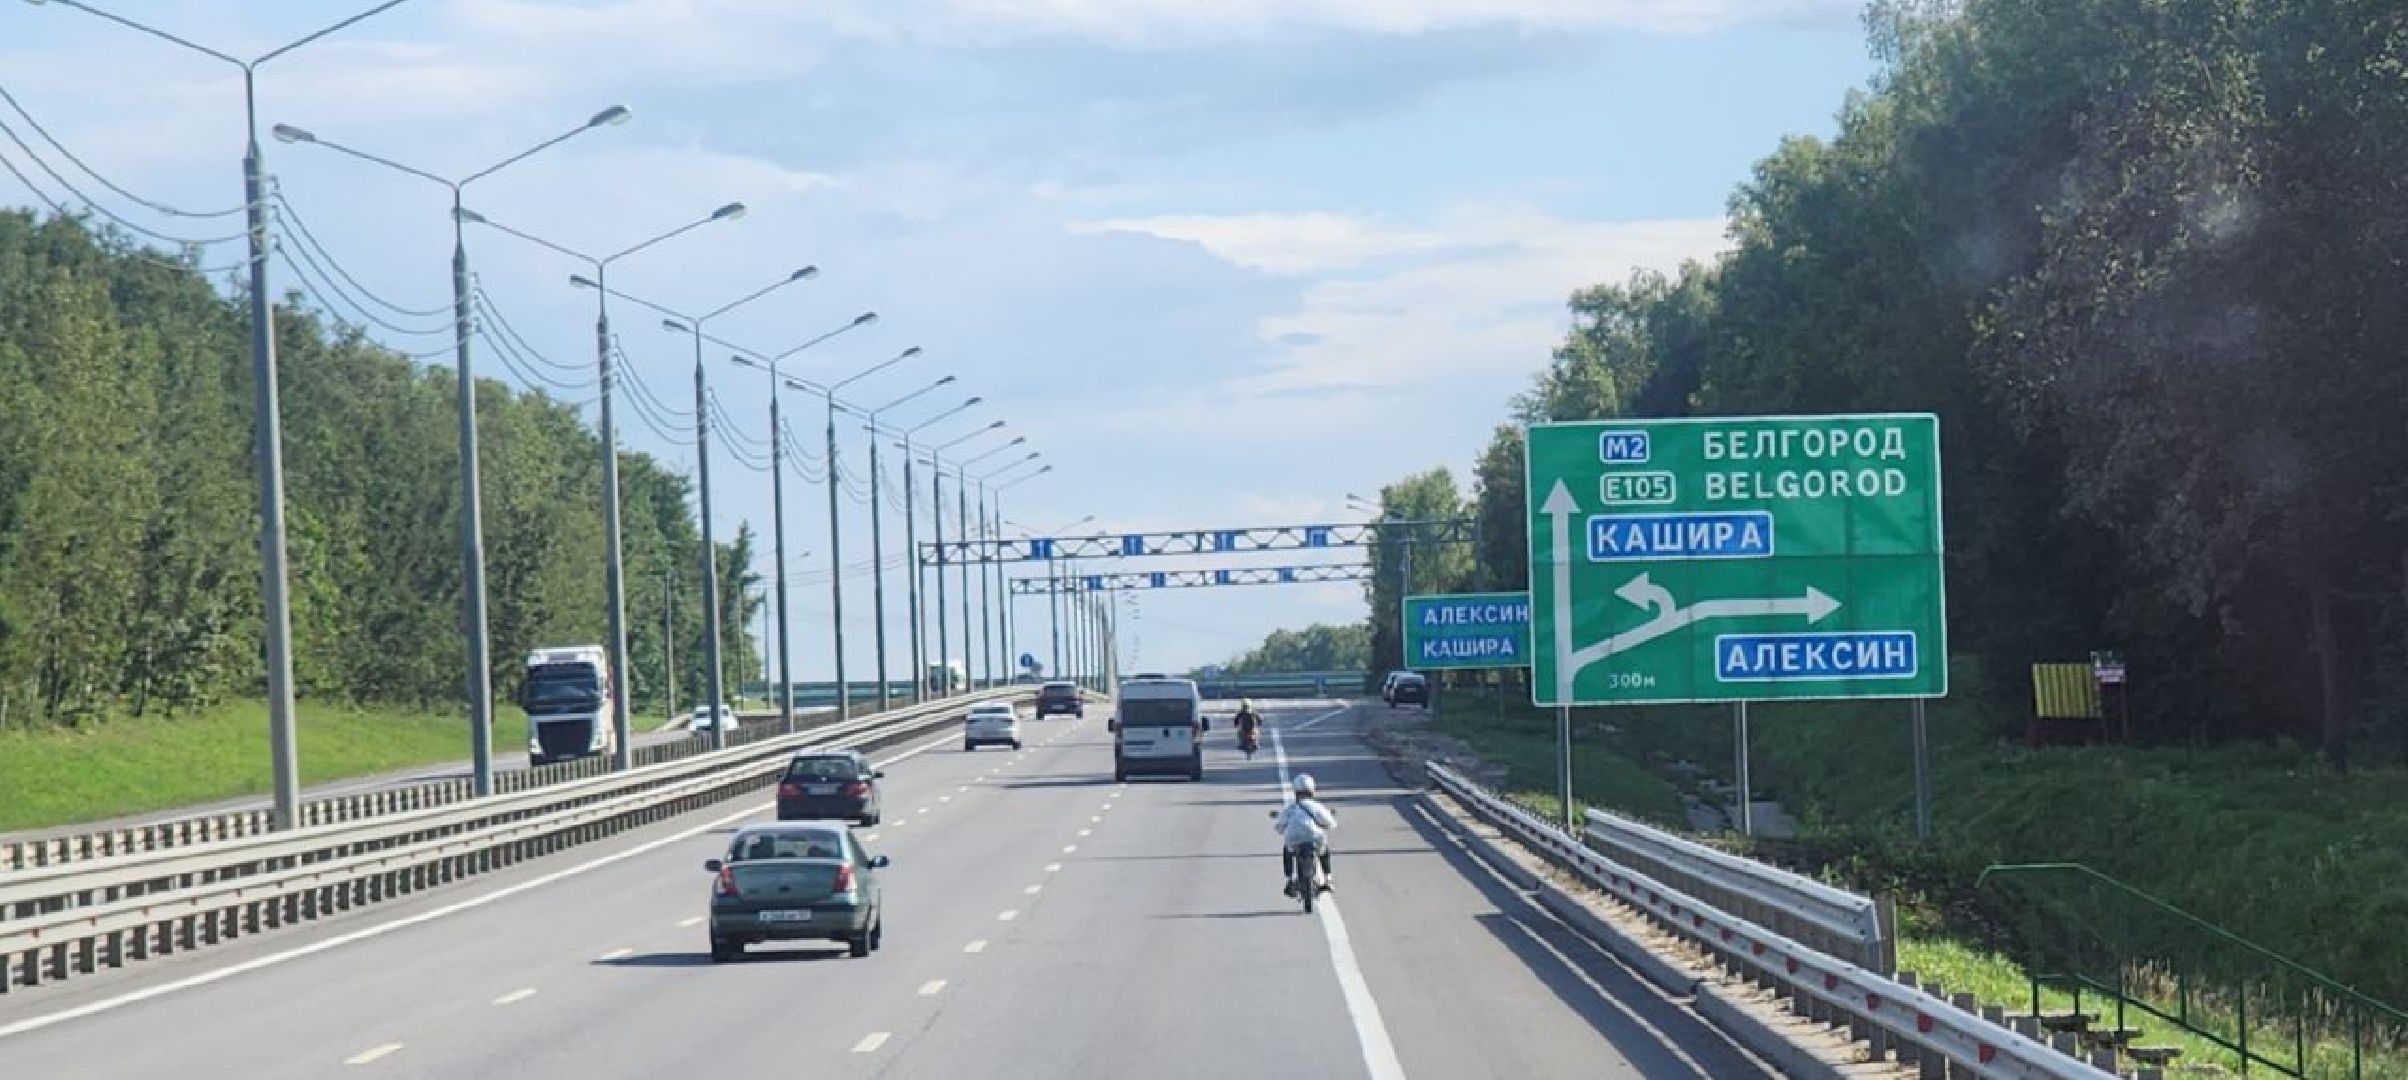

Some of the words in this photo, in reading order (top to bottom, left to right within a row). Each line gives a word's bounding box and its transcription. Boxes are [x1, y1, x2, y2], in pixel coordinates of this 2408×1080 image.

[1704, 427, 1906, 460] БЕЛГОРОД
[1606, 477, 1667, 498] E105
[1706, 468, 1906, 499] BELGOROD
[1597, 522, 1763, 553] КАШИРА
[1424, 604, 1528, 625] АЛЕКСИН
[1424, 637, 1514, 658] КАШИРА
[1726, 640, 1906, 672] АЛЕКСИН
